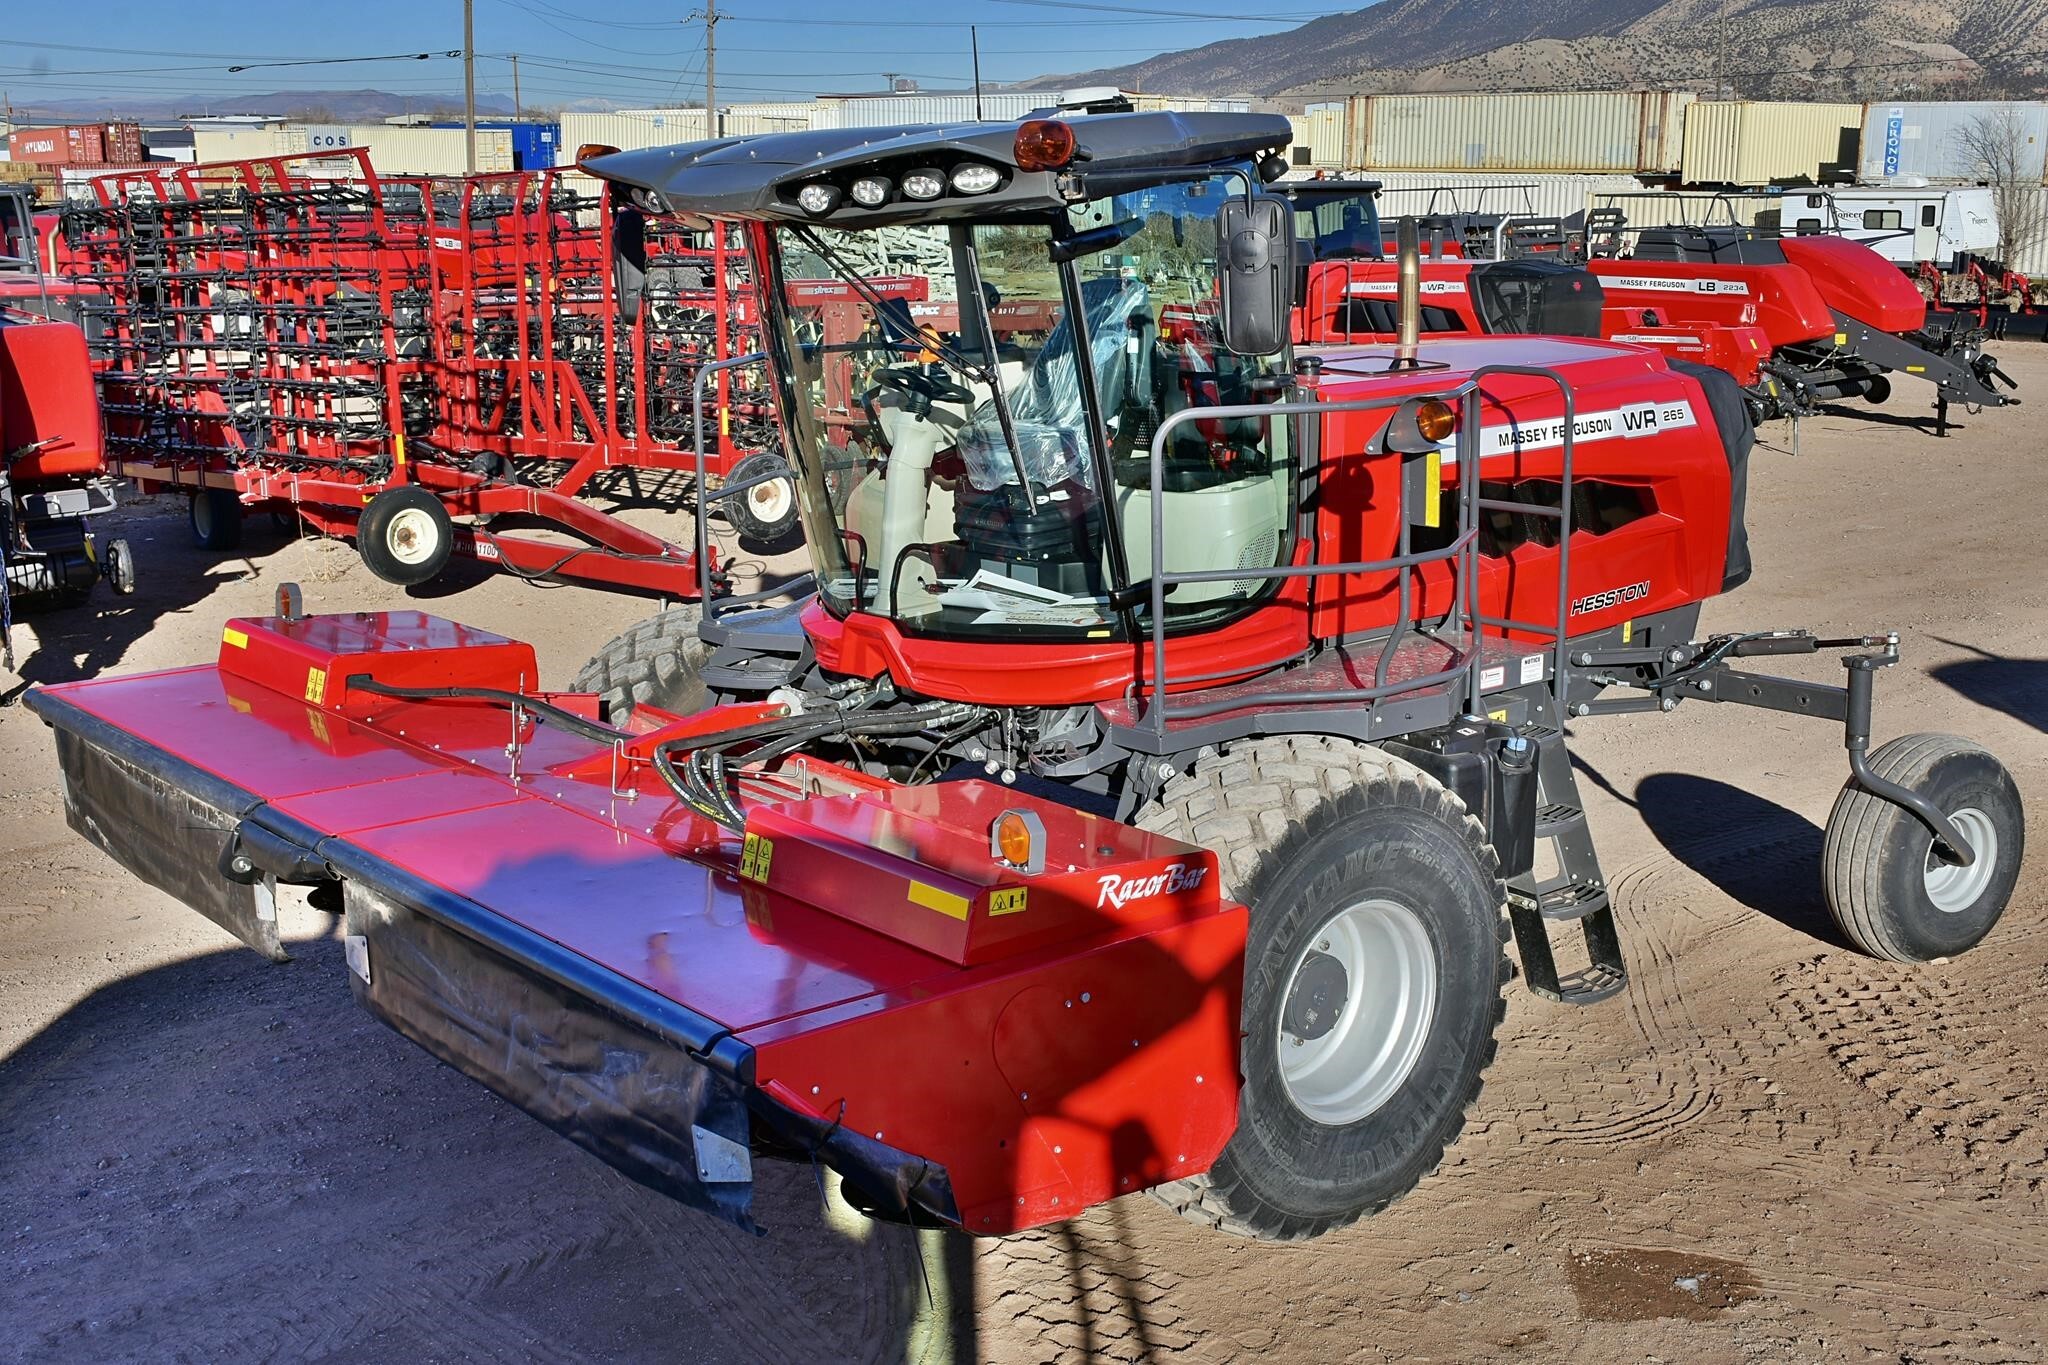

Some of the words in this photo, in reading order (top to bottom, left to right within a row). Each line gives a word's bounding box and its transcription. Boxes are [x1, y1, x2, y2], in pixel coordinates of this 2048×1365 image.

[25, 140, 54, 154] HYUNDAI
[313, 136, 346, 146] COS
[1886, 120, 1900, 174] CRONOS
[1427, 284, 1445, 292] WR
[1619, 279, 1647, 287] MASSEY
[1649, 280, 1685, 288] FERGUSON
[1698, 282, 1716, 292] LB
[1498, 426, 1548, 448] MASSEY
[1552, 417, 1613, 440] FEGUSON
[1622, 409, 1658, 432] WR
[1663, 408, 1685, 422] 265
[1570, 580, 1650, 617] HESSTON
[1524, 656, 1541, 665] NOTICE
